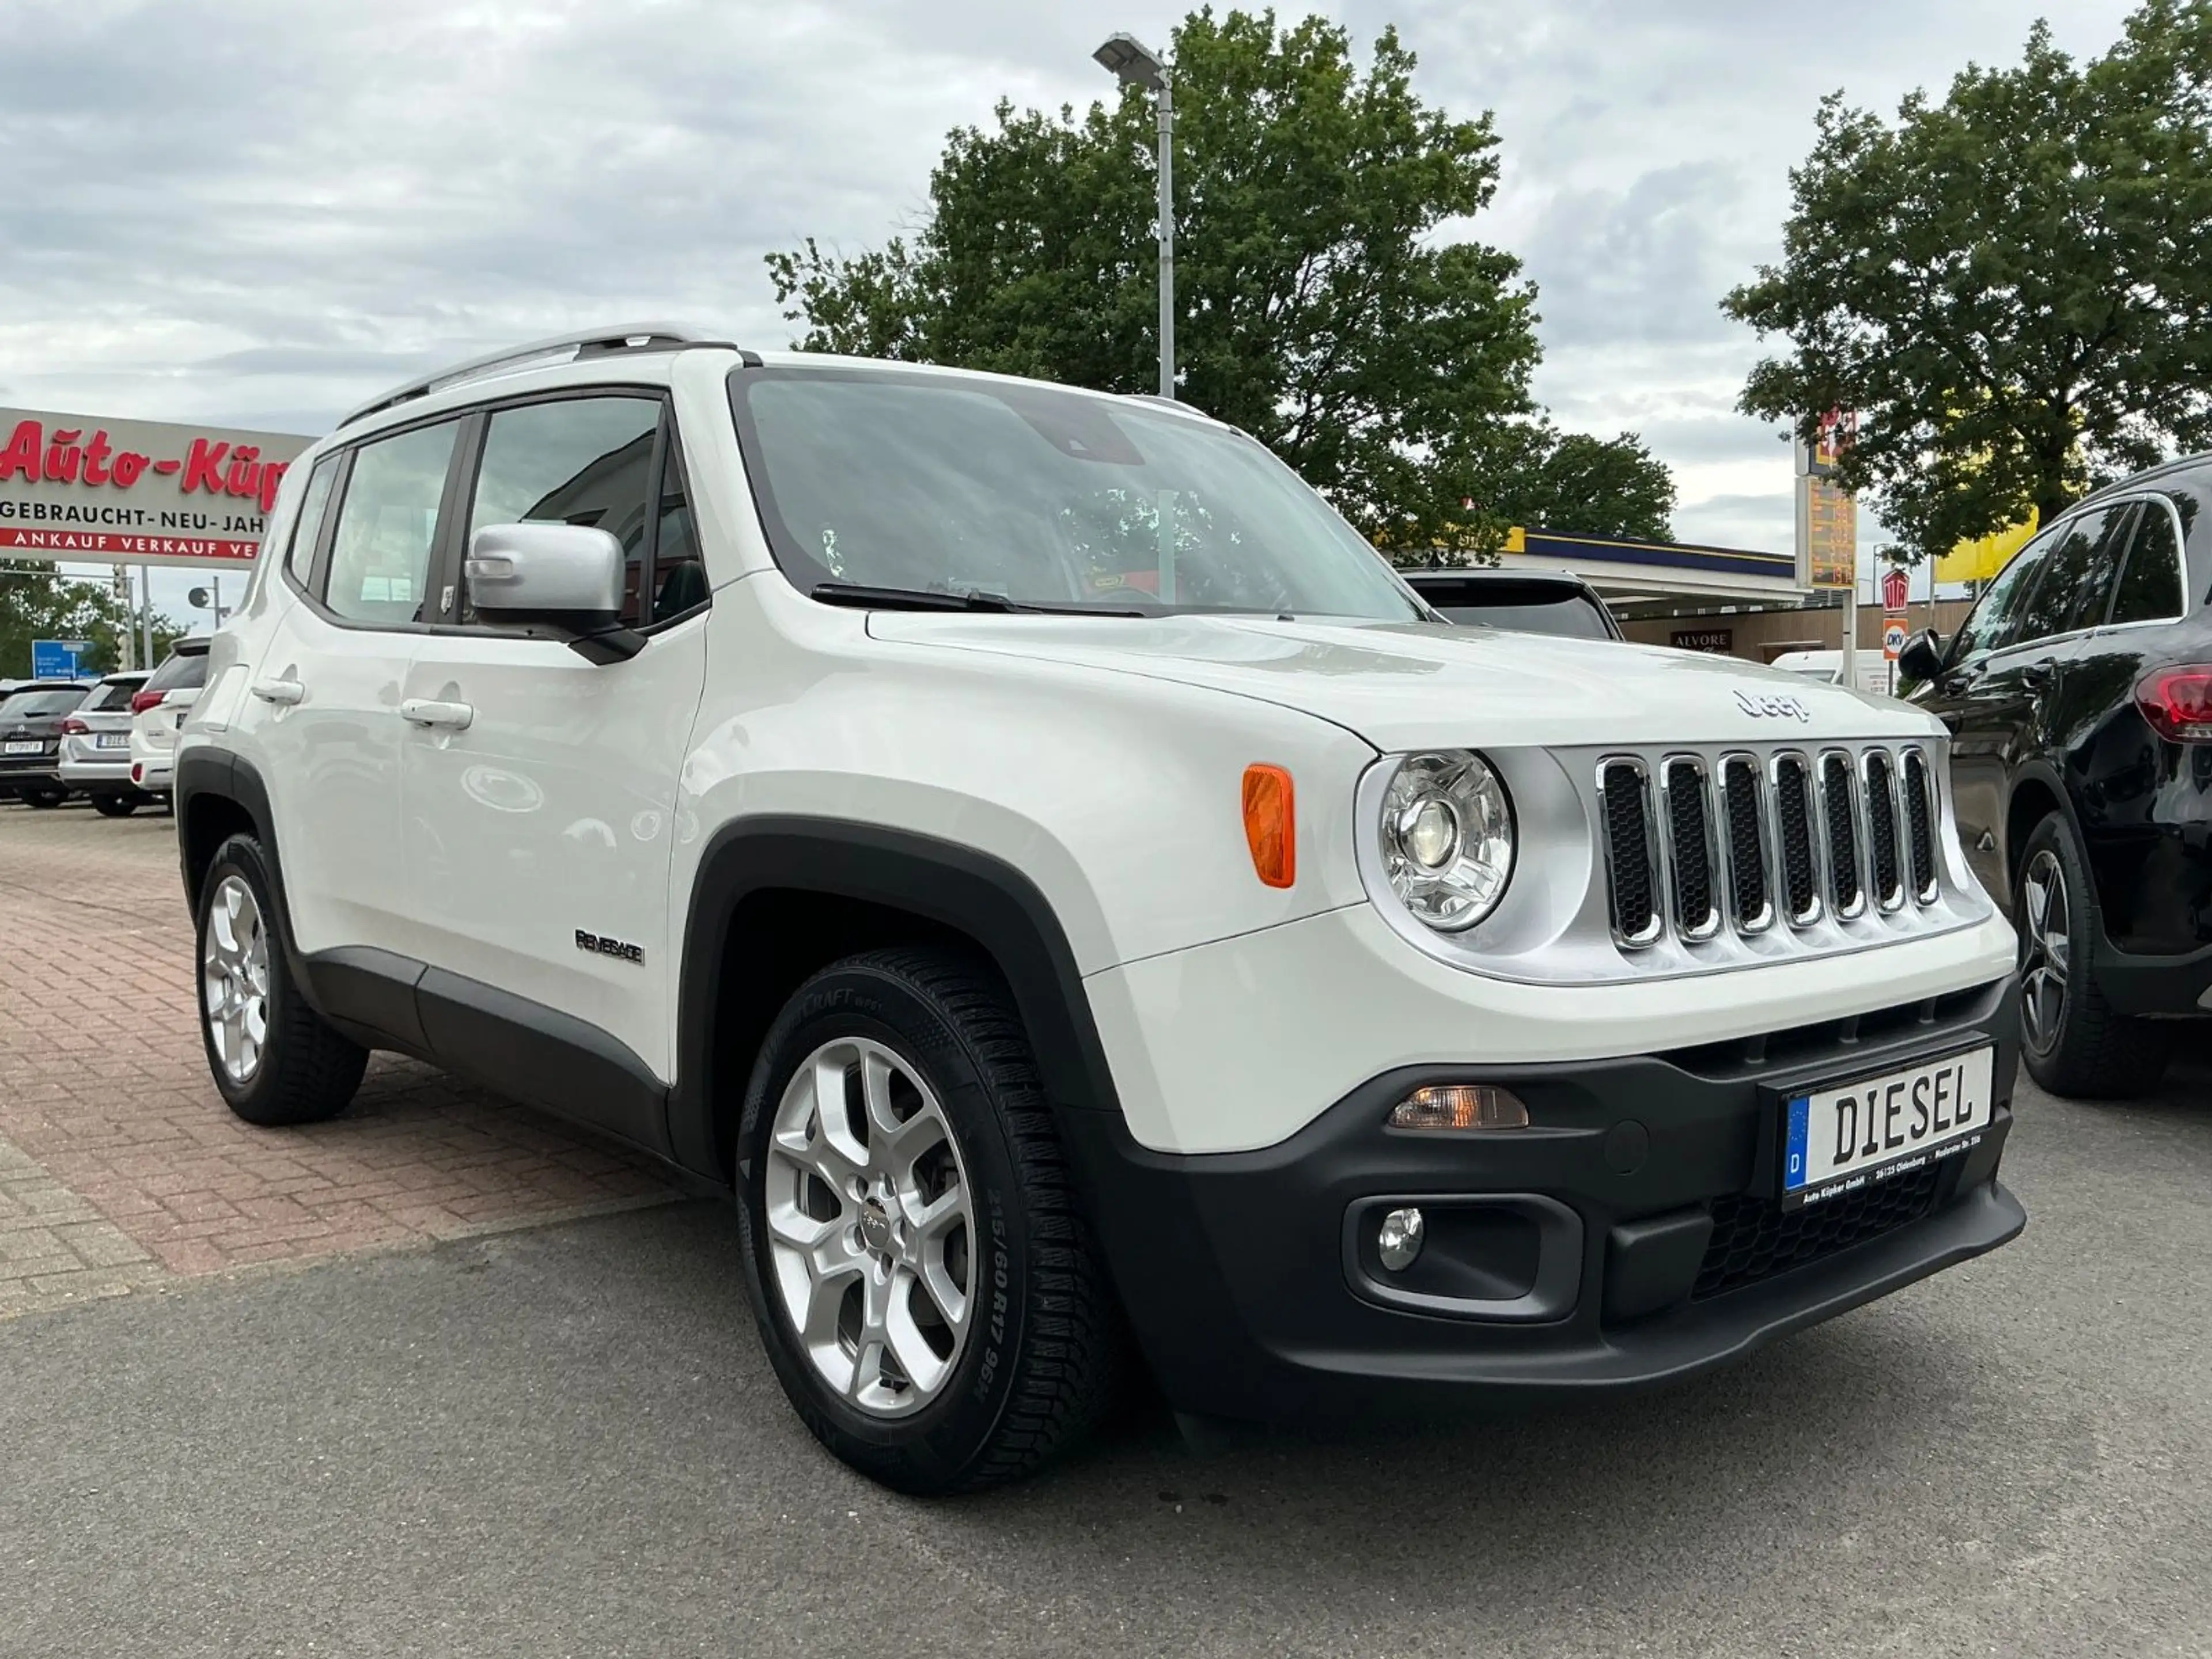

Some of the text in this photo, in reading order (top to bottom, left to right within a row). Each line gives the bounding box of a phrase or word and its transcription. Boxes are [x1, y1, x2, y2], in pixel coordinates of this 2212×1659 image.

[14, 531, 108, 549] ANKAUF
[121, 537, 218, 555] VERKAUF
[1675, 634, 1727, 647] ALVORE
[1730, 688, 1810, 723] Jeep
[575, 928, 645, 966] RENEGADE
[1832, 1064, 1973, 1166] DIESEL
[1790, 1153, 1800, 1174] D
